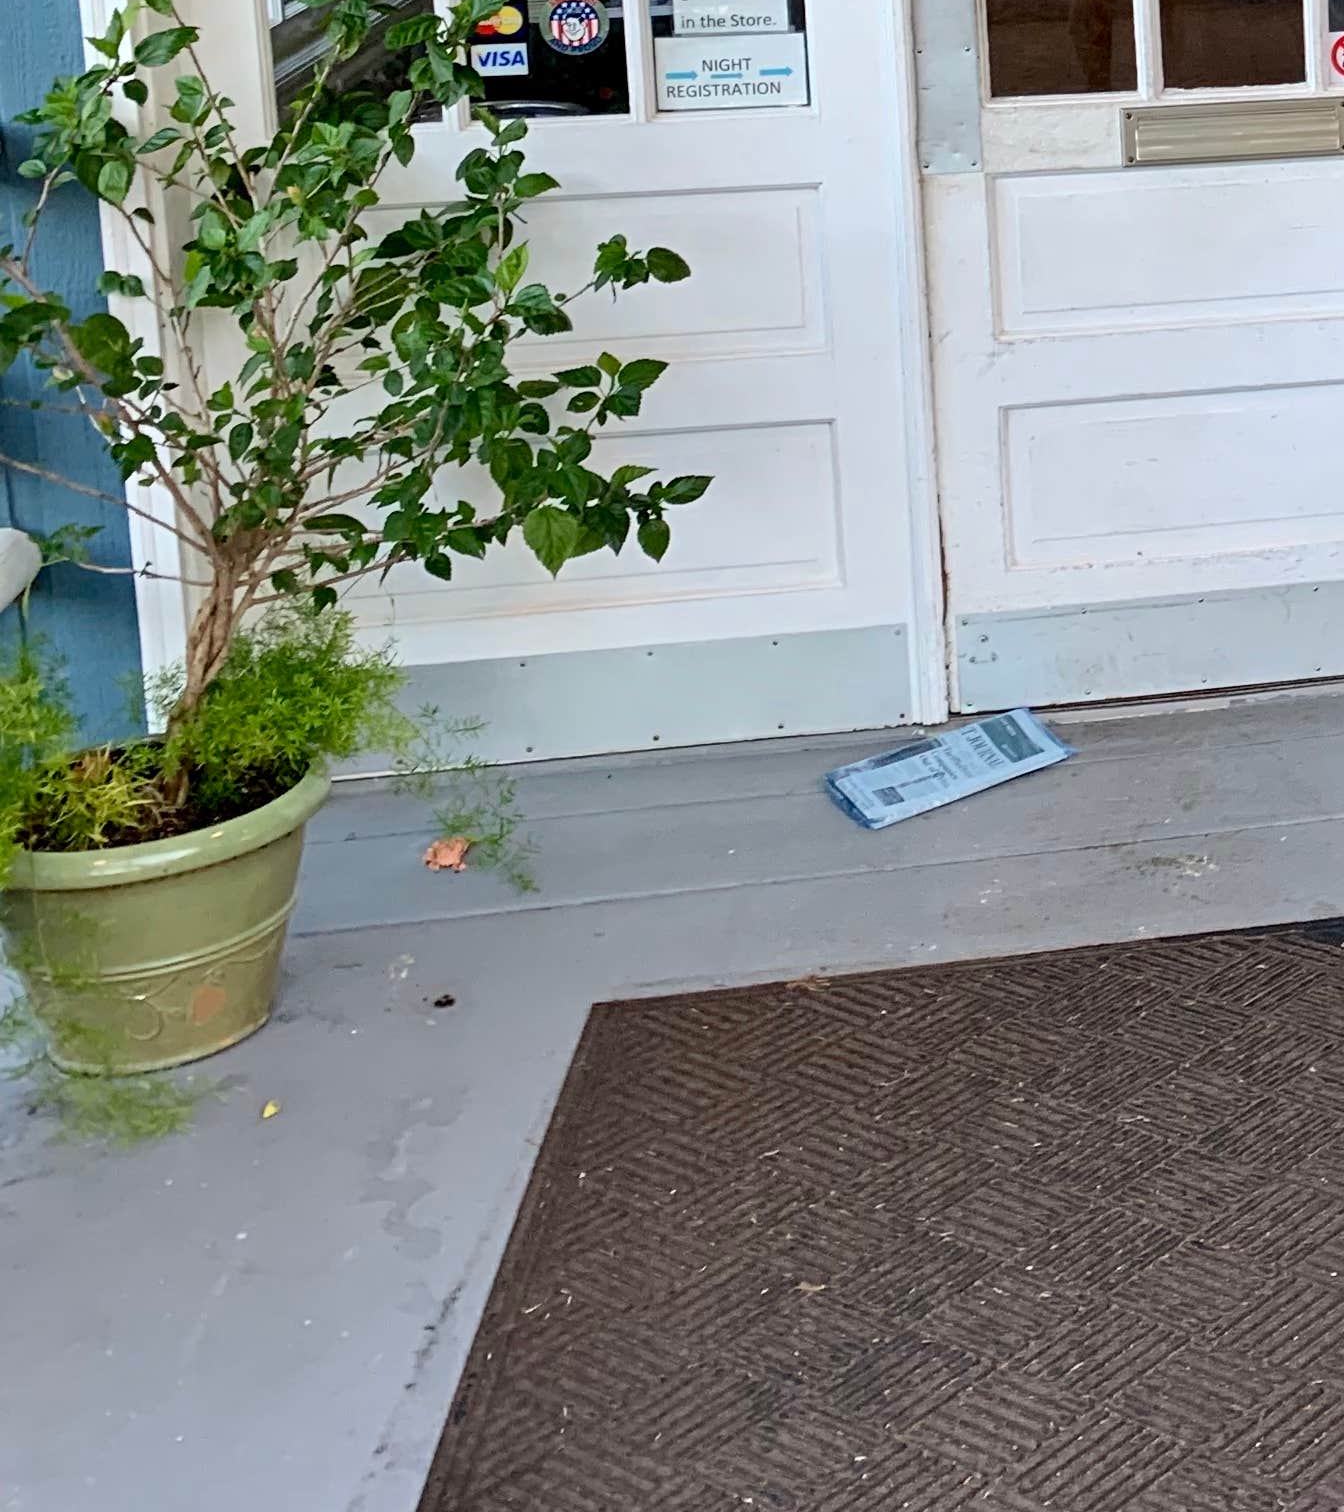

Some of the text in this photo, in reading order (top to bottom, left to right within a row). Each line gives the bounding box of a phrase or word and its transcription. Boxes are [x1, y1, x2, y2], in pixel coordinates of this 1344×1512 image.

[681, 14, 777, 29] in the Store.
[477, 50, 526, 68] VISA
[701, 57, 753, 73] NIGHT
[665, 81, 782, 99] REGISTRATION
